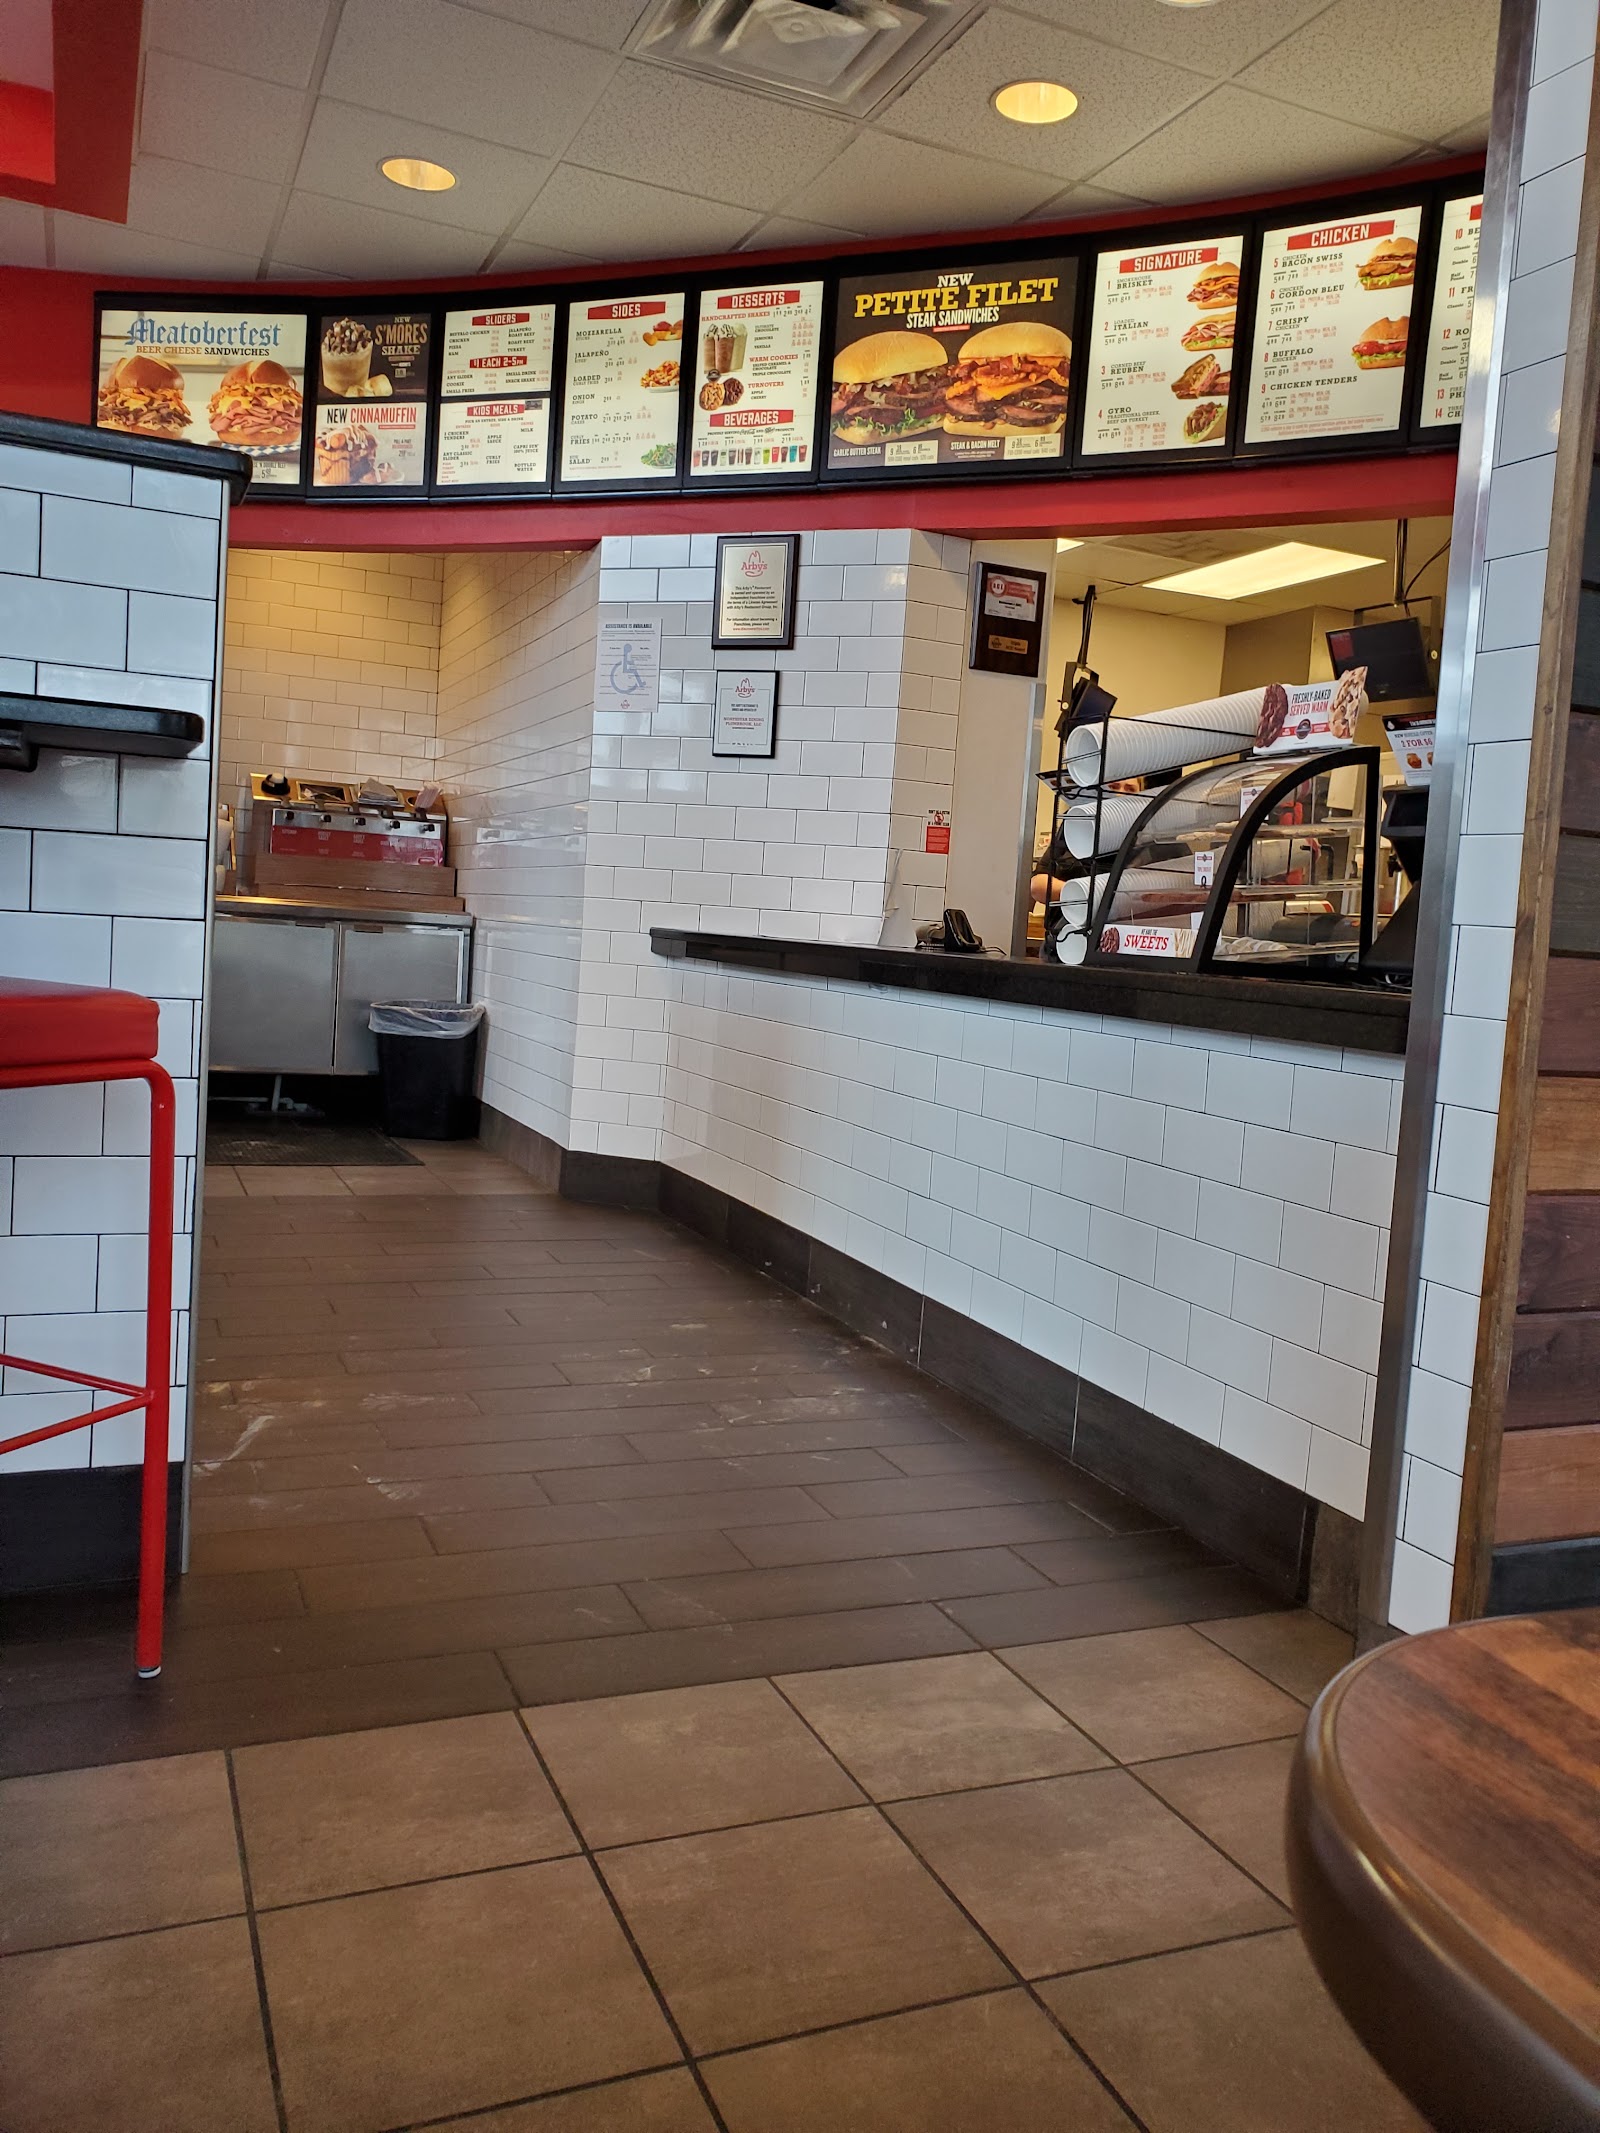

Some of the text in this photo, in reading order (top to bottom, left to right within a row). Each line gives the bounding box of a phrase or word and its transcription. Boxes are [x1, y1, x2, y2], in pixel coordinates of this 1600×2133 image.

[1310, 224, 1370, 247] CHICKEN
[1455, 228, 1463, 240] 10
[1134, 249, 1203, 272] SIGNATURE
[1273, 257, 1279, 268] 5
[1282, 253, 1308, 261] CHICKEN
[1282, 252, 1343, 268] BACON SWISS
[937, 273, 974, 288] NEW
[1116, 275, 1152, 283] SMOKEHOUSE
[1116, 279, 1153, 290] BRISKET
[1107, 280, 1111, 290] 1
[1279, 285, 1304, 293] CHICKEN
[854, 277, 1059, 318] PETITE FILET
[1270, 289, 1275, 300] 6
[1278, 284, 1345, 300] CORDON BLEU
[1448, 287, 1455, 298] 11
[732, 291, 785, 308] DESSERTS
[612, 303, 641, 318] SIDES
[485, 314, 517, 325] SLIDERS
[701, 313, 747, 322] HANDCRAFTED
[906, 311, 937, 329] STEAK
[938, 307, 1000, 326] SANDWICHES
[1276, 316, 1310, 327] CRISPY
[1104, 322, 1109, 331] 2
[1113, 321, 1149, 331] ITALIAN
[1268, 320, 1273, 332] 7
[1275, 323, 1300, 331] CHICKEN
[124, 318, 282, 347] Meatoberfest
[375, 323, 428, 345] S'MORES
[576, 328, 622, 337] MOZZARELLA
[1443, 328, 1451, 340] 12
[136, 345, 270, 357] BEER CHEESE SANDWICHES
[381, 345, 420, 356] SHAKE
[574, 350, 610, 359] JALAPEÑO
[1272, 347, 1314, 358] BUFFALO
[482, 358, 501, 368] EACH
[1264, 352, 1269, 363] 8
[1101, 365, 1106, 375] 3
[1110, 366, 1145, 375] REUBEN
[748, 381, 784, 389] TURNOVERS
[1261, 383, 1266, 394] 9
[1270, 375, 1358, 391] CHICKEN TENDERS
[572, 393, 595, 401] ONION
[1437, 388, 1445, 400] 13
[327, 407, 417, 424] NEW CINNAMUFFIN
[472, 405, 519, 416] KIDS MEALS
[1107, 406, 1132, 415] GYRO
[1107, 412, 1141, 420] TRADITIONAL
[1435, 408, 1443, 418] 14
[724, 411, 779, 426] BEVERAGES
[950, 439, 1001, 451] STEAK & BACON MELT
[833, 446, 882, 457] GARLIC BUTTER STEAK
[741, 560, 768, 572] Arby's
[735, 685, 755, 695] Arby's
[1291, 689, 1332, 705] FRESHLY-BAKED
[1289, 700, 1329, 716] SERVED WARM
[1406, 739, 1423, 747] FOR
[1124, 934, 1169, 950] SWEETS
